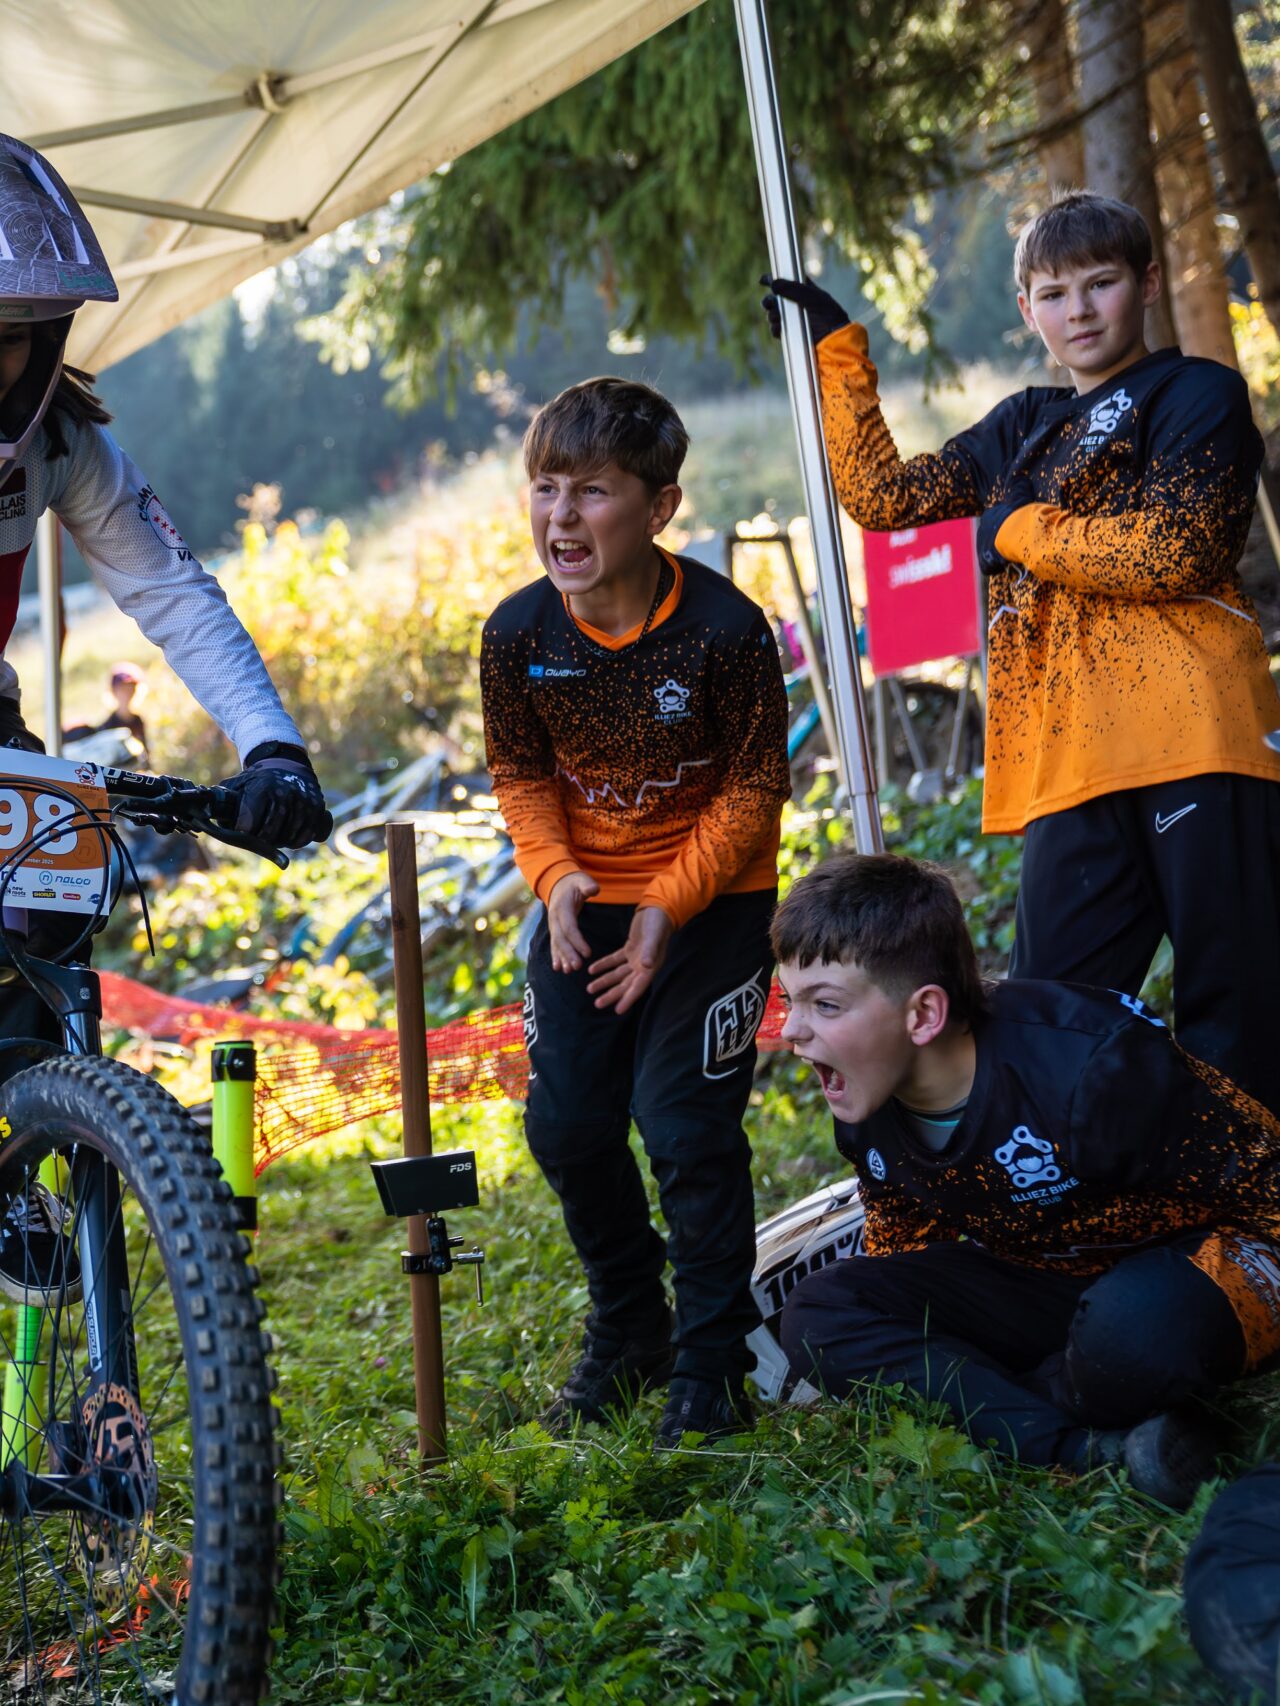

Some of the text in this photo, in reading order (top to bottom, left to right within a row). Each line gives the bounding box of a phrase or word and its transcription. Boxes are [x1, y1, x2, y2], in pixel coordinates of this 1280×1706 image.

[450, 1162, 472, 1174] FDS
[1010, 1176, 1080, 1203] ILLIEZ BIKE
[1038, 1195, 1062, 1206] CLUB
